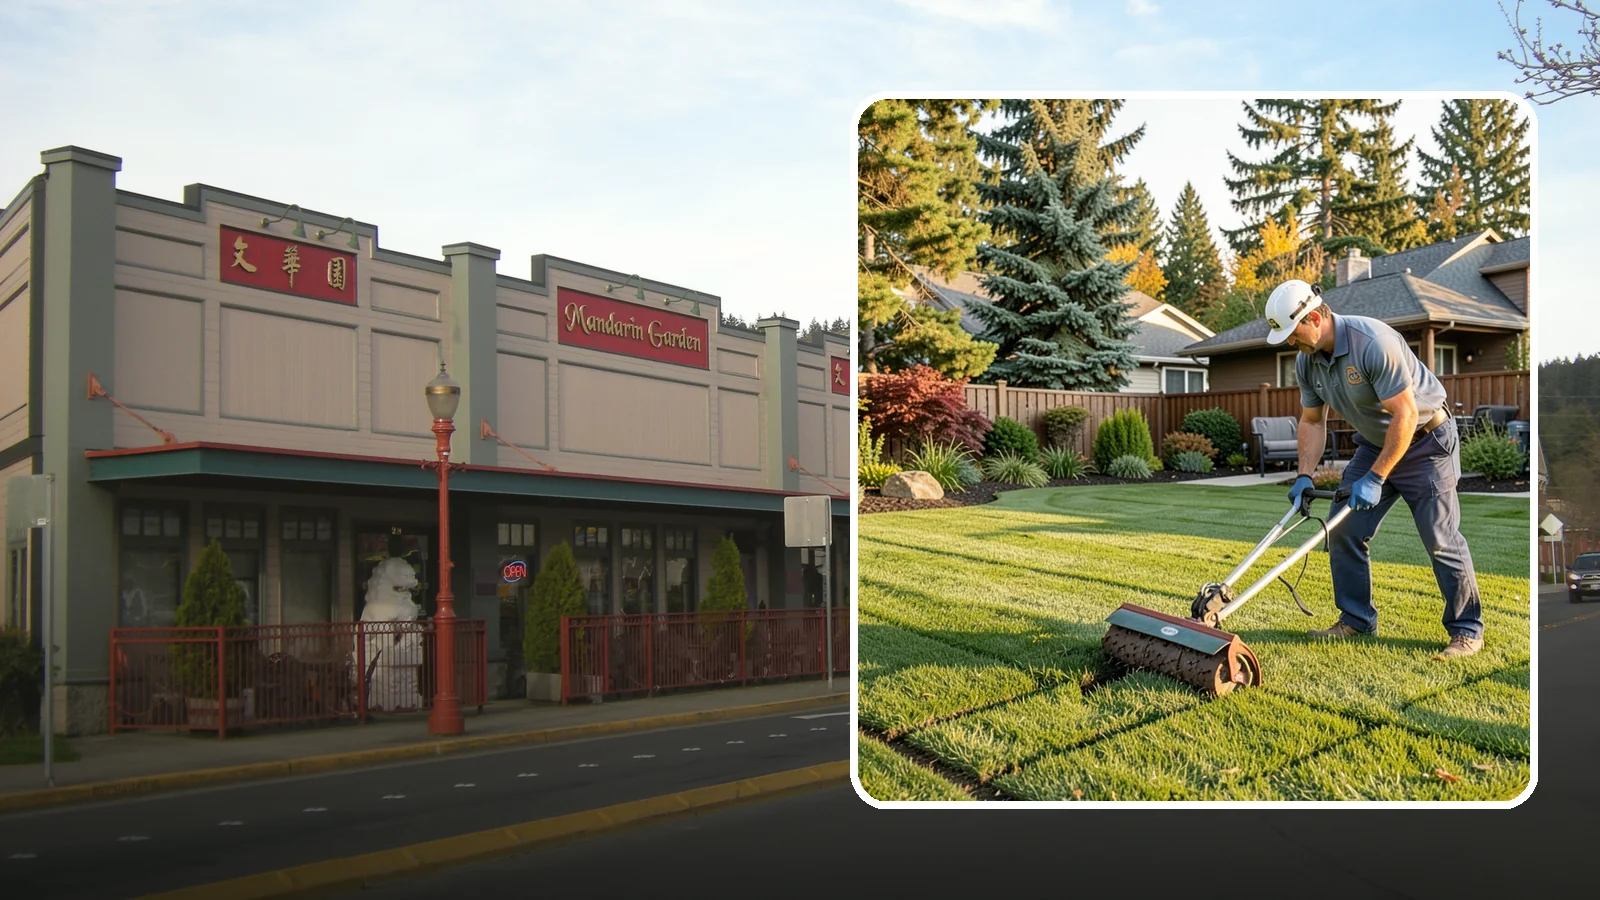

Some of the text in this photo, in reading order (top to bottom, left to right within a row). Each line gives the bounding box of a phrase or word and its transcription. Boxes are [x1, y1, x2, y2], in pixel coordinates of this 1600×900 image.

[230, 235, 347, 292] 文華園
[564, 301, 702, 352] Mandarin Garden
[503, 565, 527, 578] OPEN
